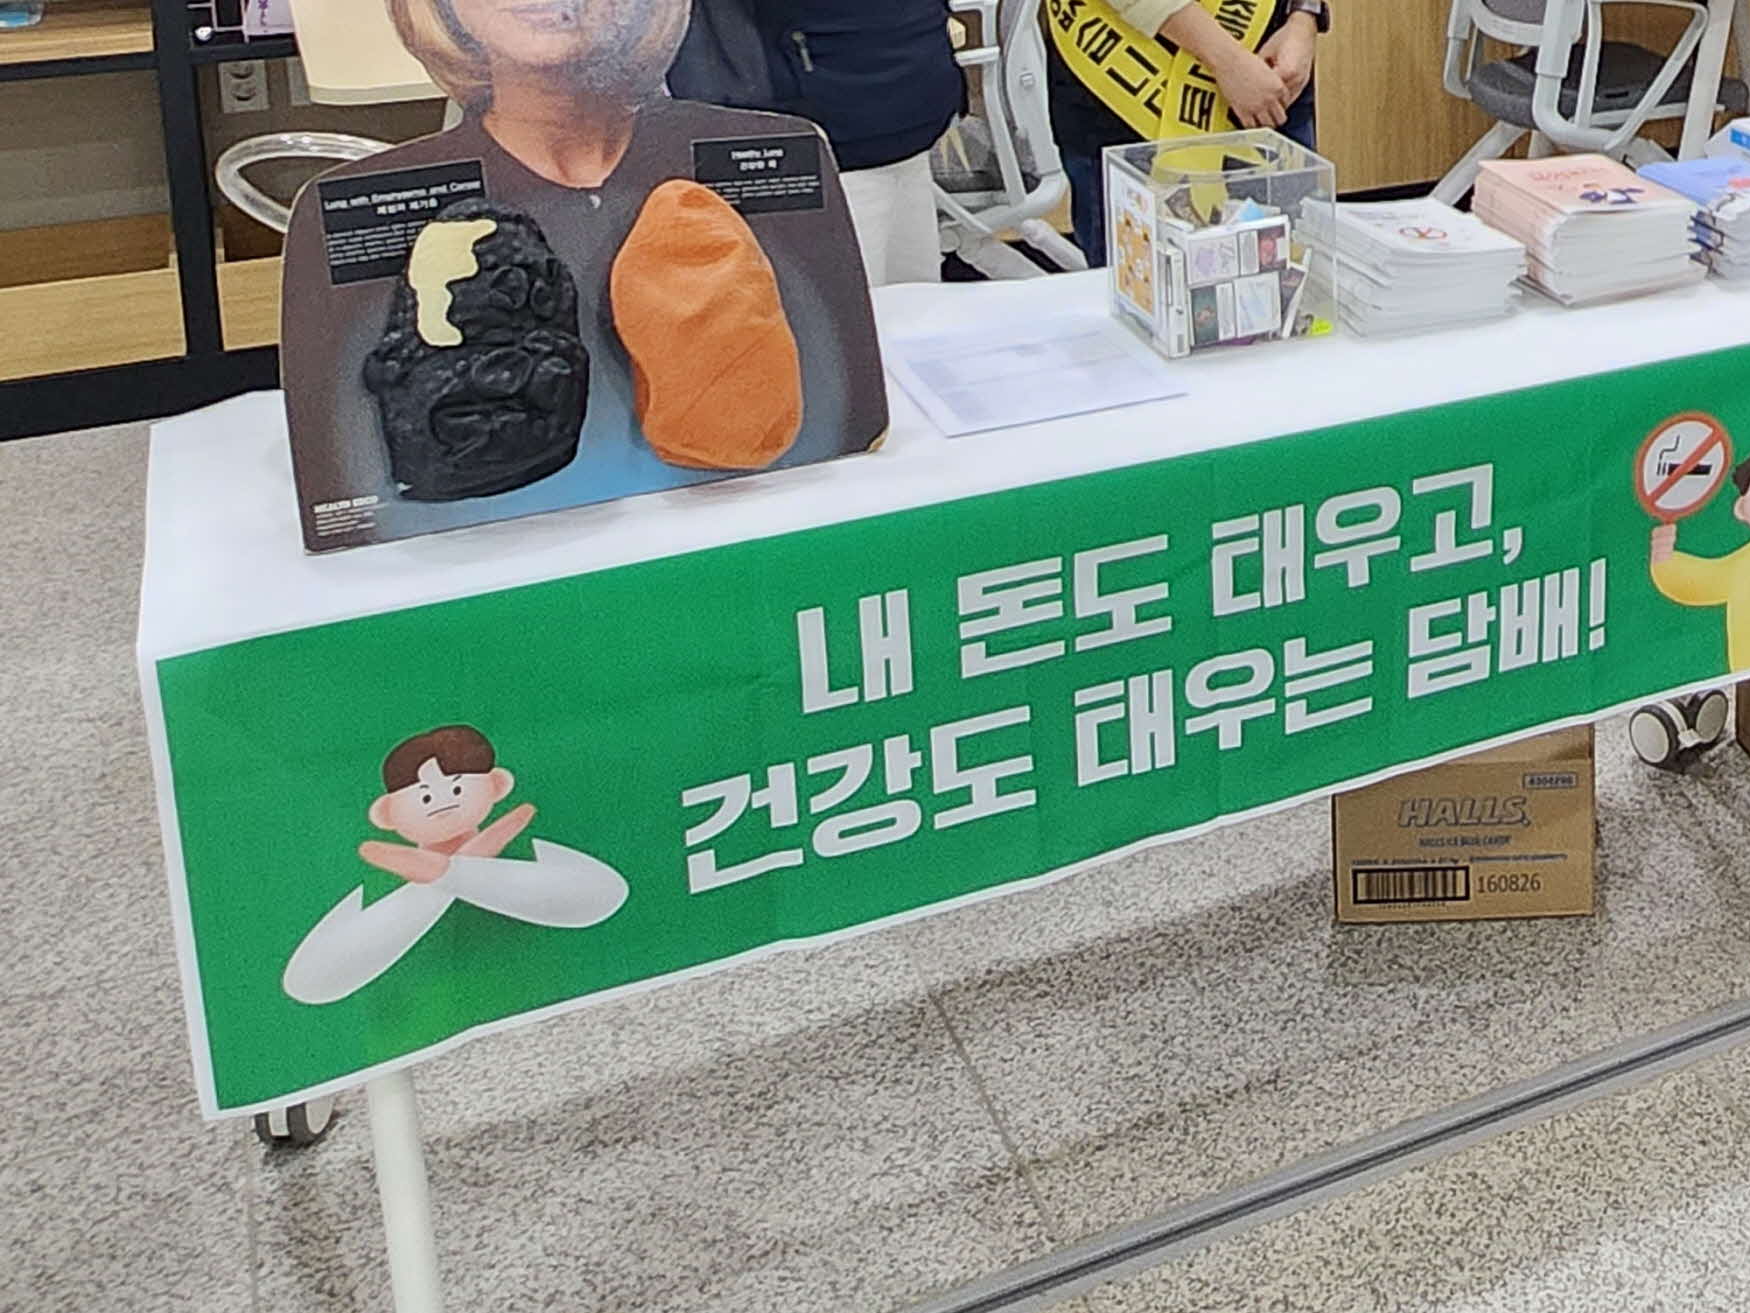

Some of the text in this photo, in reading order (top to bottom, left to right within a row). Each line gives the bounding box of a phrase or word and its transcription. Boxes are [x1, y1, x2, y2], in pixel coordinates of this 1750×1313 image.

[797, 463, 1524, 716] 내 돈도 태우고,
[681, 557, 1608, 894] 건강도 태우는 담배!
[1399, 795, 1529, 828] HALLS
[1476, 872, 1542, 894] 160826
